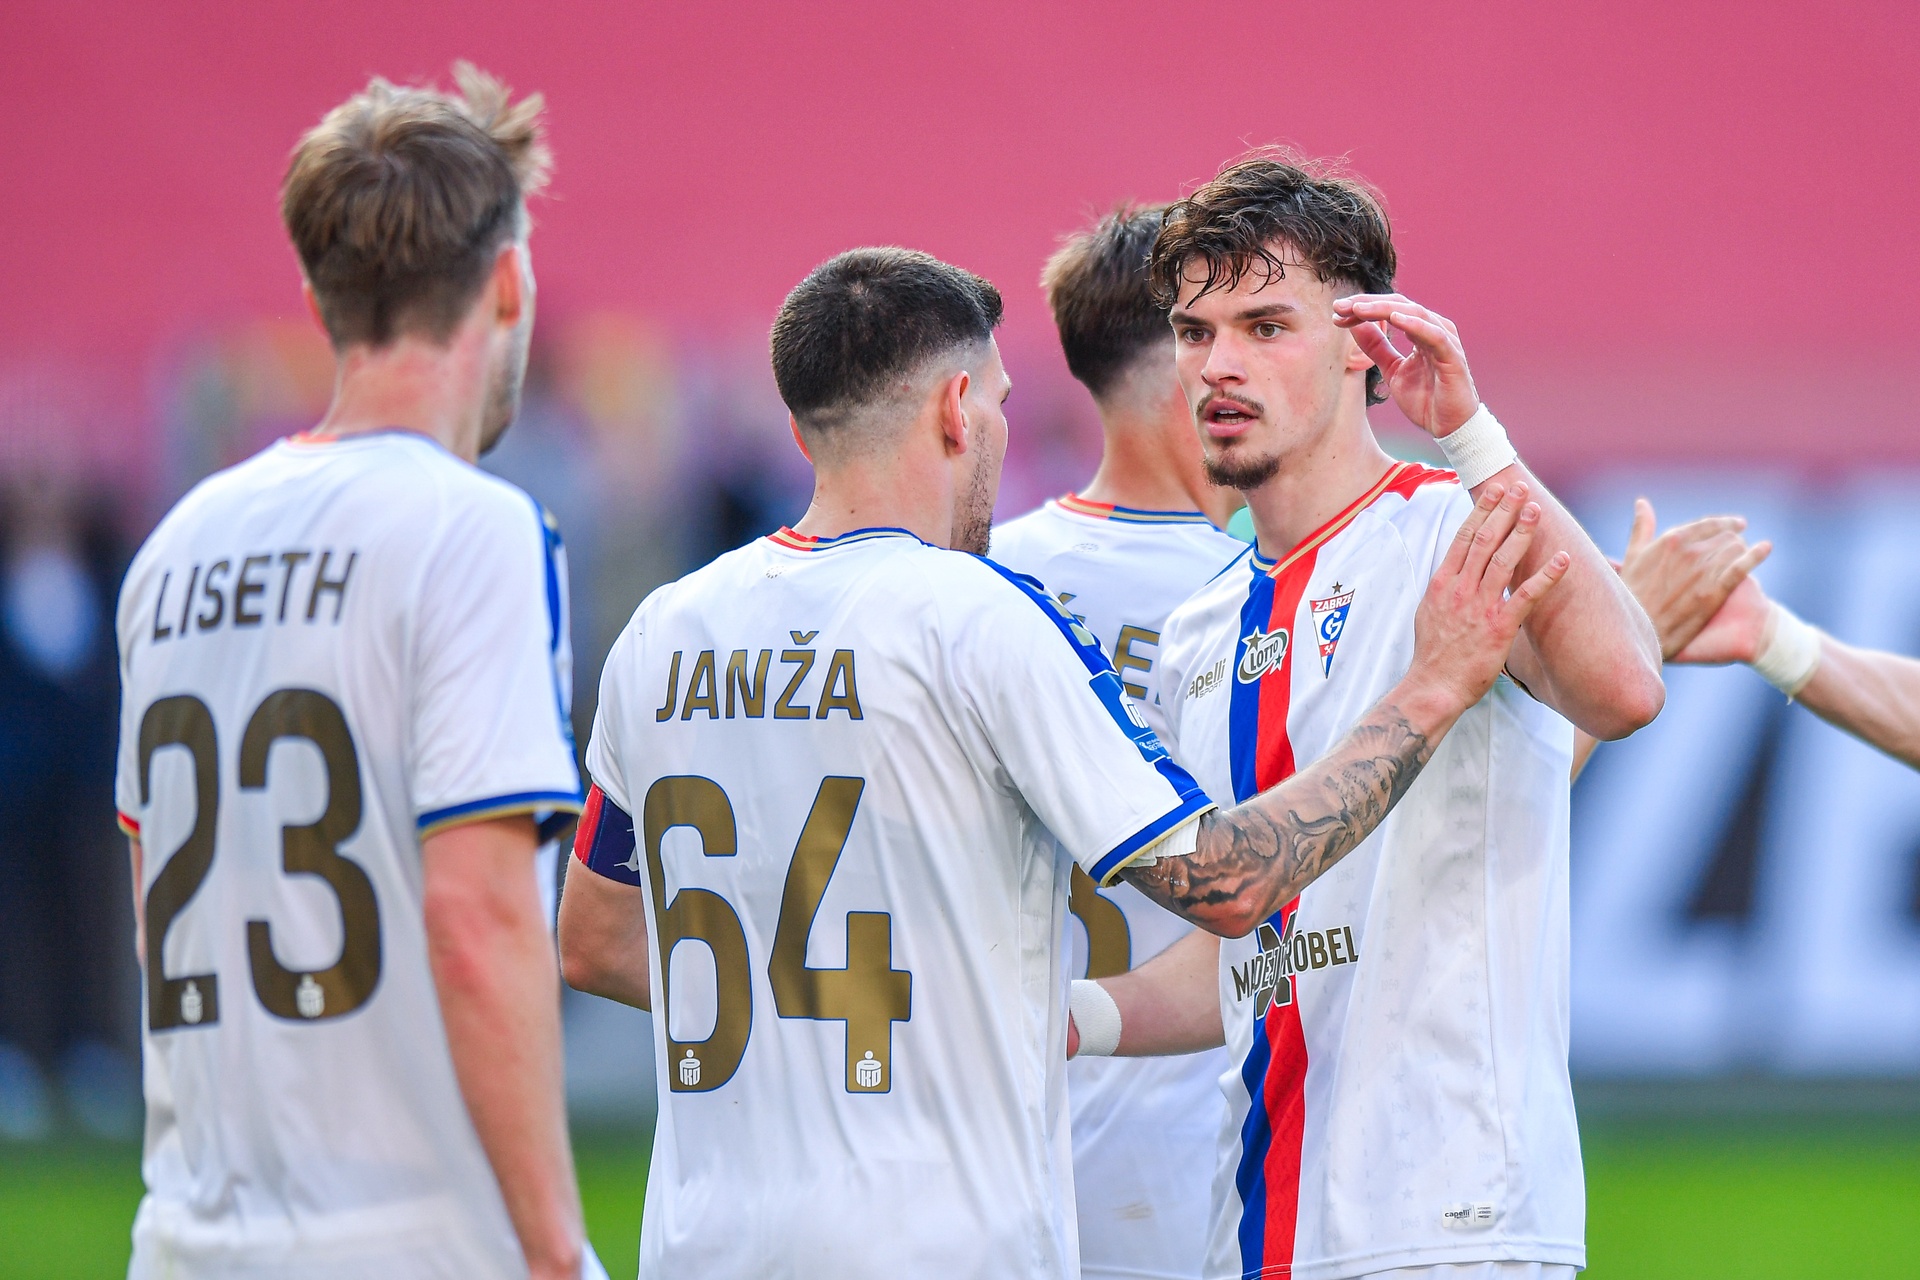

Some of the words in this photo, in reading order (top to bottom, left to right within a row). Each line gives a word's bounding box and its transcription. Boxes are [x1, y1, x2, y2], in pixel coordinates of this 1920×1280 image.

[151, 551, 358, 644] LISETH
[1314, 593, 1354, 612] ZABRZE
[656, 630, 864, 722] JANŽA
[1250, 639, 1279, 672] LOTTO
[138, 688, 382, 1035] 23
[643, 775, 912, 1093] 64
[1444, 1209, 1470, 1219] capelli
